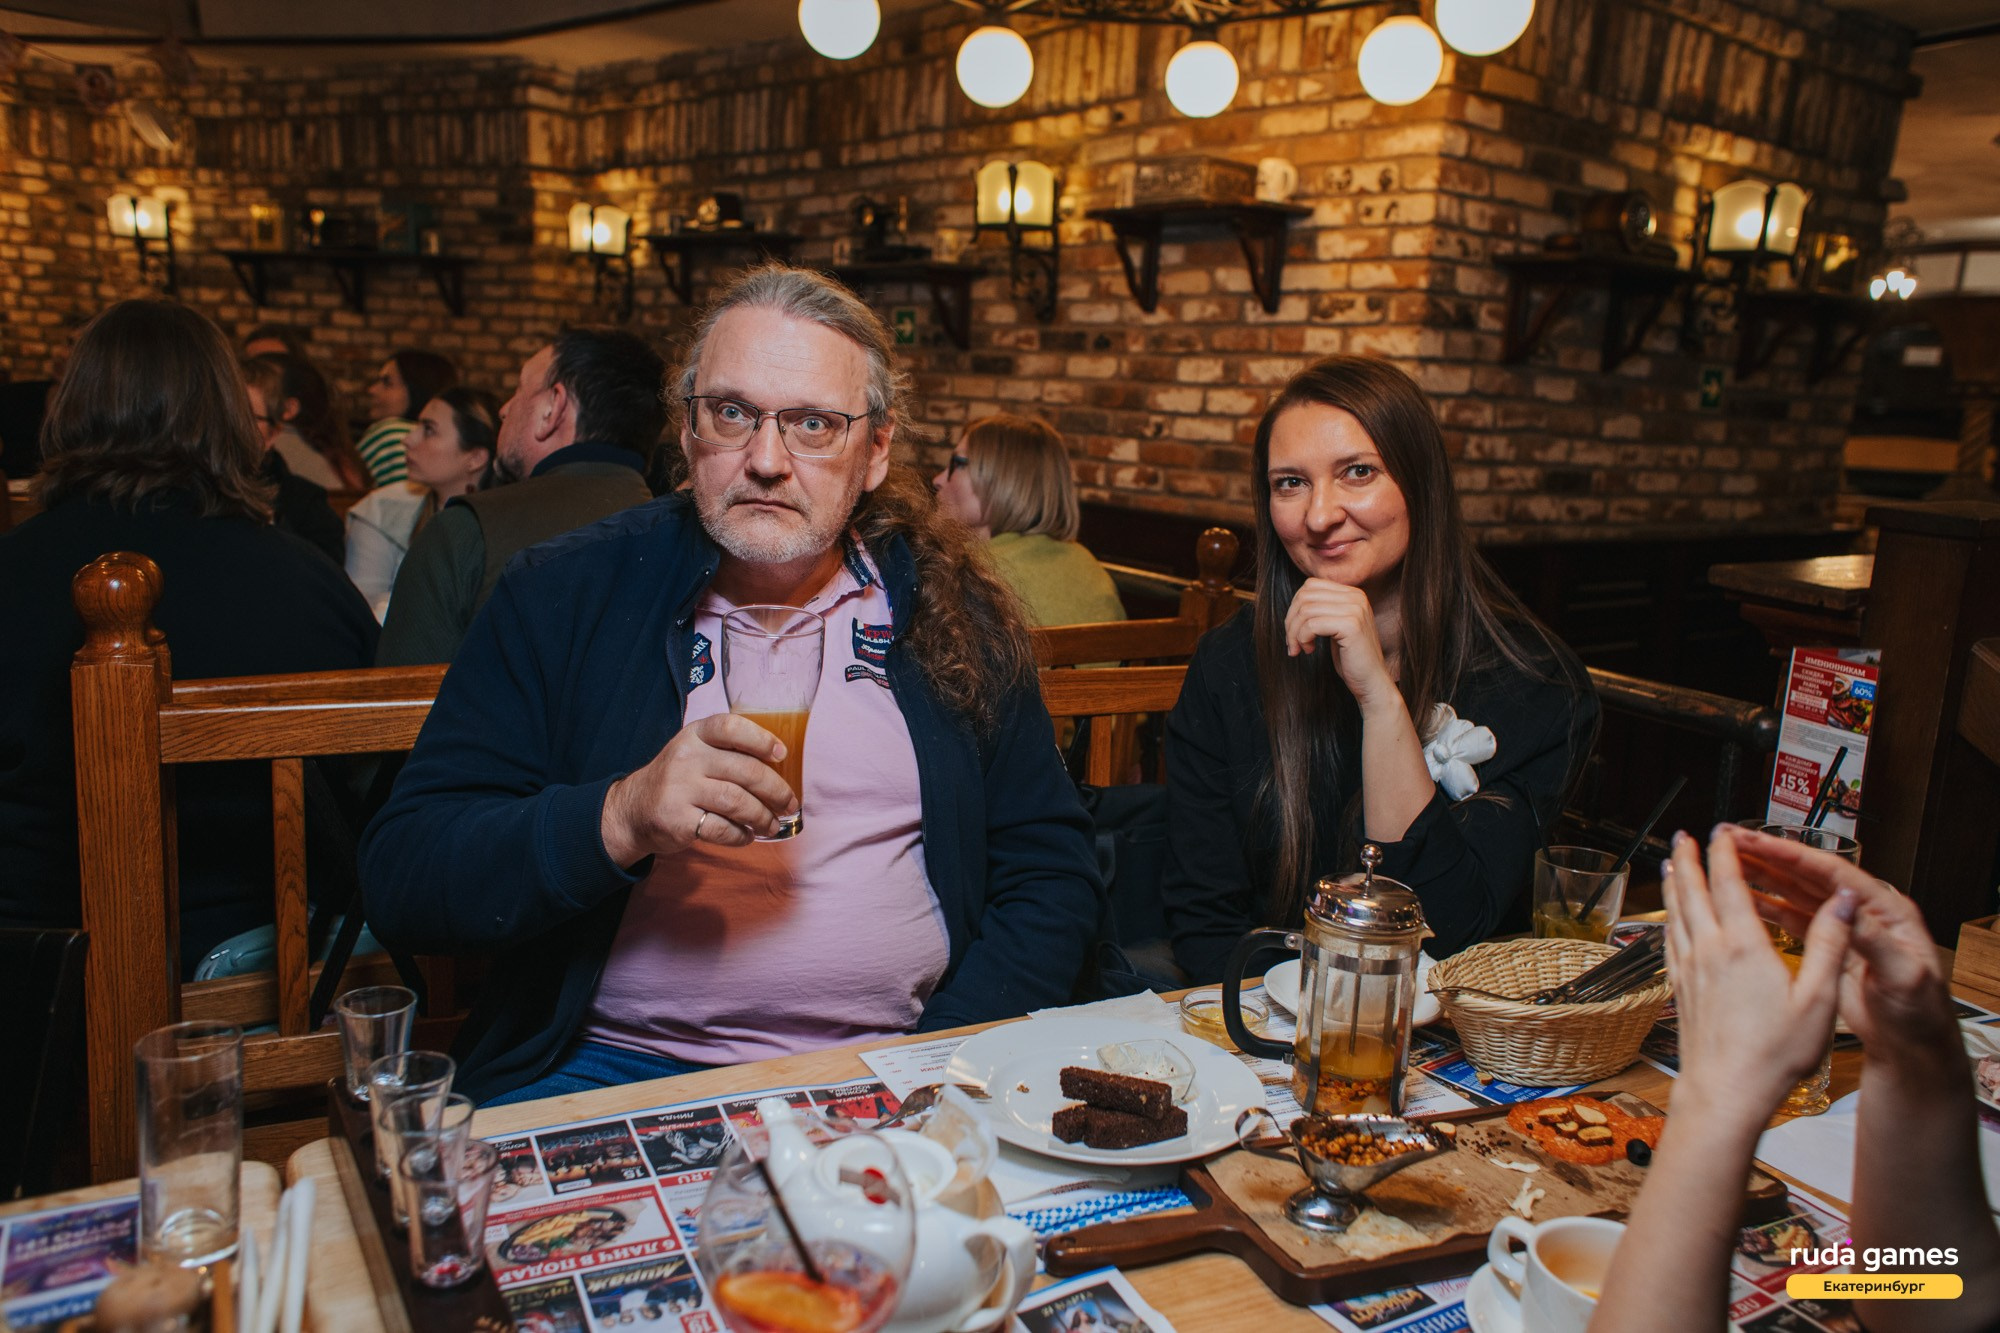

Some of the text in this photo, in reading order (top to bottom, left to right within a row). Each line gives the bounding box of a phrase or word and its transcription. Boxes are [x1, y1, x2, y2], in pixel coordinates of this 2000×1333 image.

[692, 639, 709, 659] ARK
[1854, 686, 1873, 698] 60%
[658, 1112, 694, 1121] ЛИНДА
[662, 1239, 675, 1250] 6
[600, 1240, 658, 1263] ЛАНЧ
[580, 1255, 595, 1266] В
[497, 1258, 577, 1284] ПОДАР
